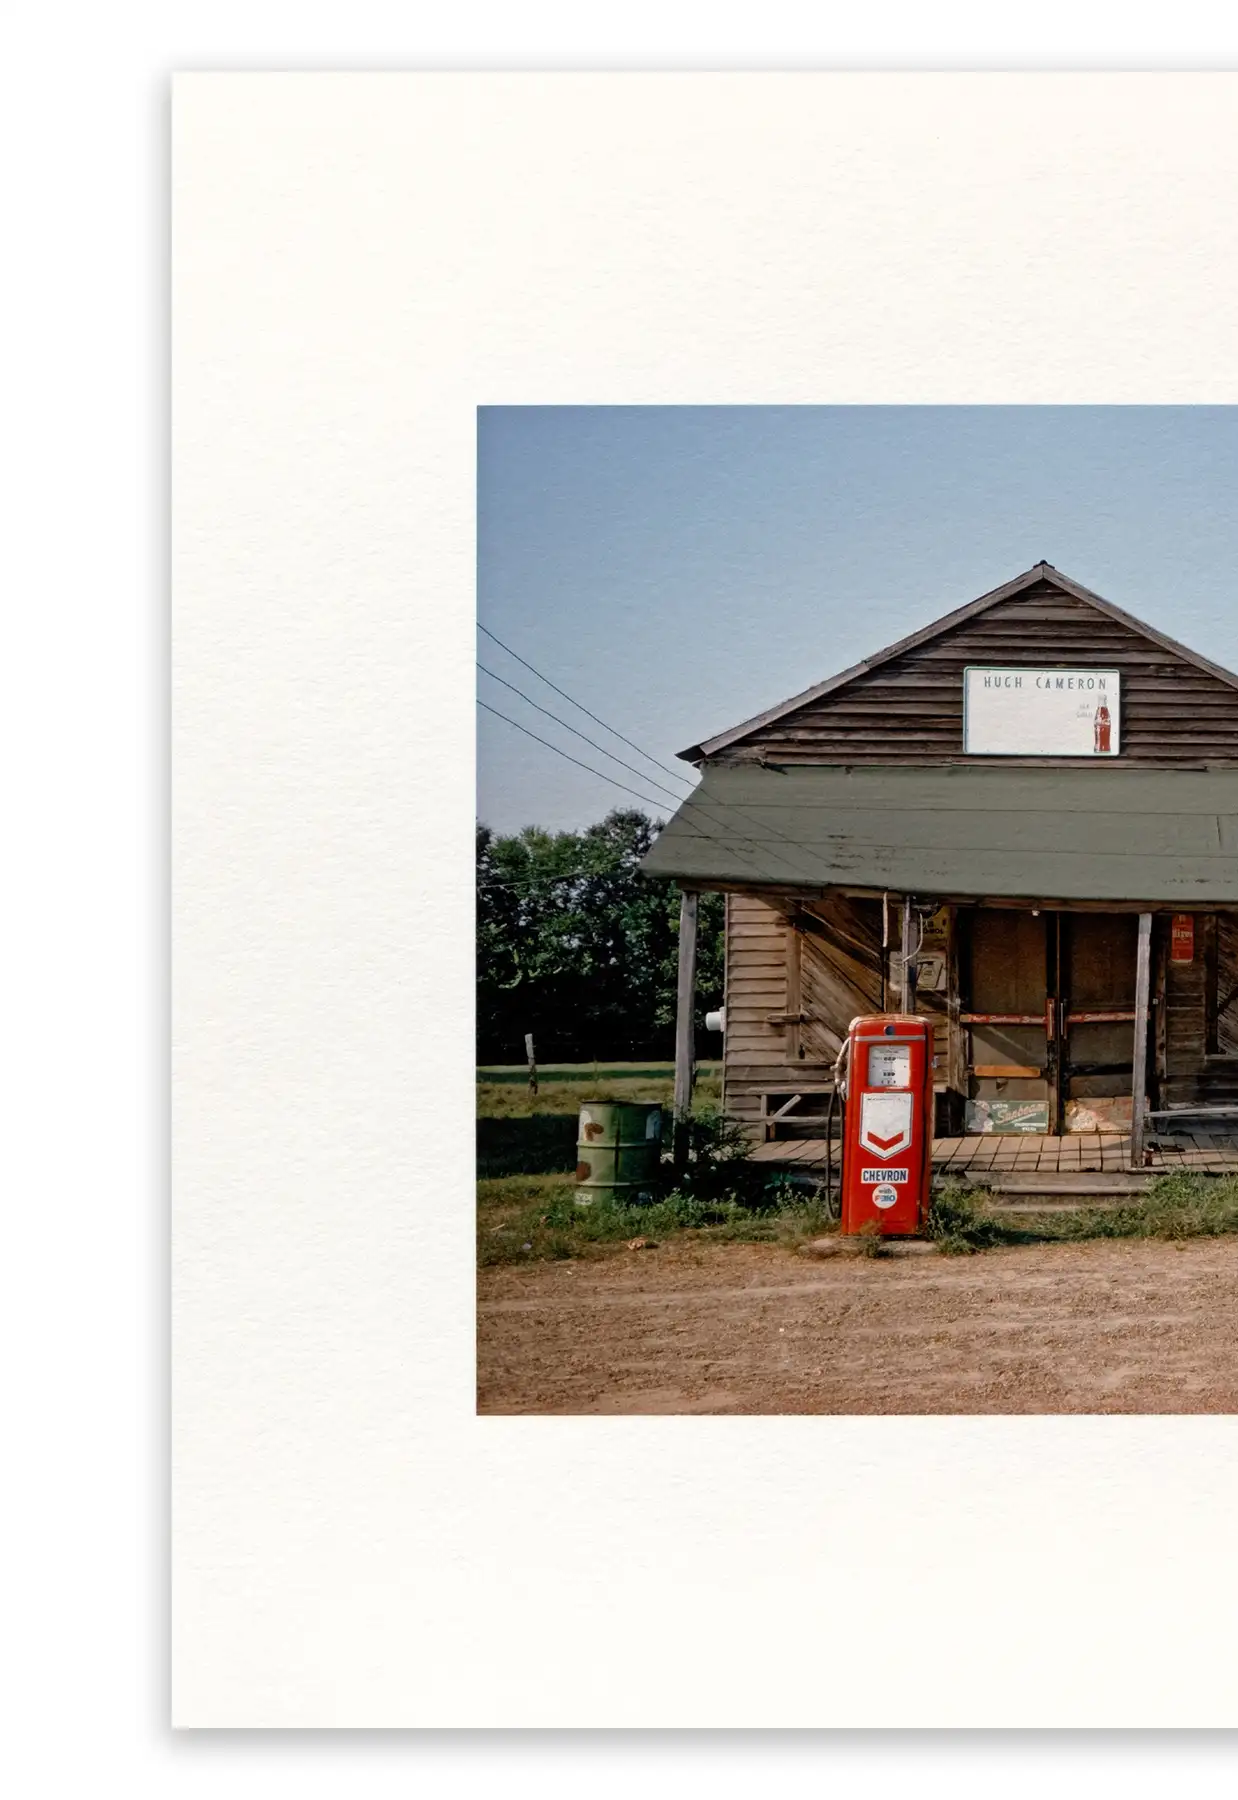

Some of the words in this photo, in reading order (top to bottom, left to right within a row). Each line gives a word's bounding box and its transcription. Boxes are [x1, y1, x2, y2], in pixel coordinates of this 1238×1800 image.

[983, 676, 1023, 689] HUGH
[1035, 677, 1107, 690] CAMERON
[863, 1170, 907, 1182] CHEVRON
